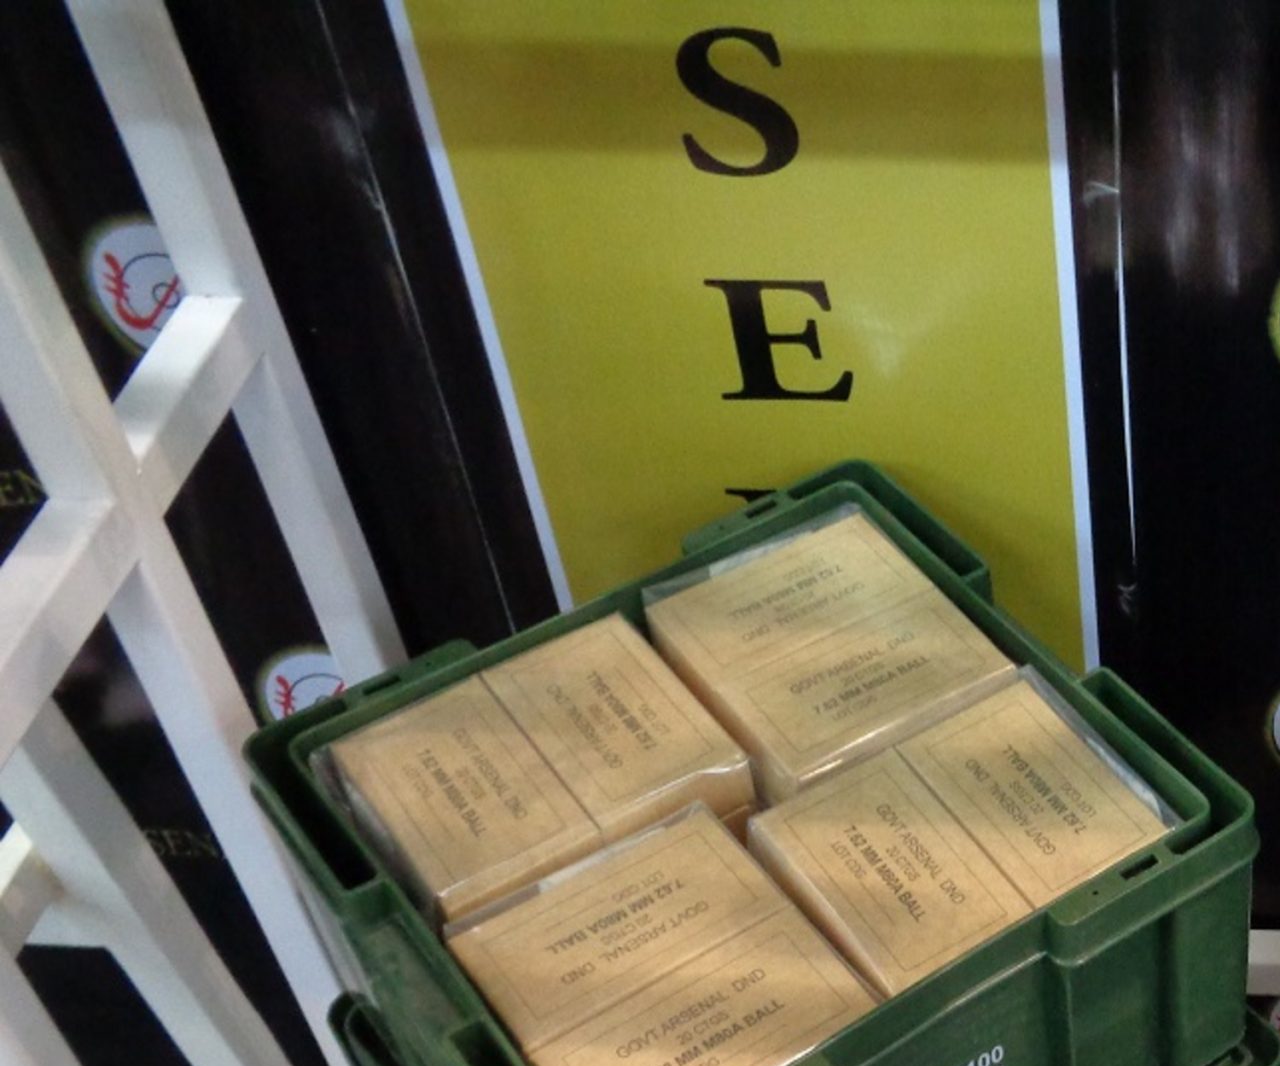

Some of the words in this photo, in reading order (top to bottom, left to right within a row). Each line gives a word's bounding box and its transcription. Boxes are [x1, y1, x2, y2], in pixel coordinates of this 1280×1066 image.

[1002, 744, 1030, 771] BALL
[1046, 795, 1069, 814] MM
[875, 803, 907, 830] GOVT
[900, 832, 943, 879] ARSENAL
[939, 878, 967, 904] DND
[844, 825, 866, 847] 7.62
[860, 845, 883, 866] MM
[897, 891, 926, 923] BALL
[654, 878, 685, 899] 7.62
[628, 894, 656, 913] MM
[668, 900, 710, 928] GOVT
[544, 930, 588, 955] BALL
[598, 922, 668, 963] ARSENAL
[560, 961, 596, 985] DND
[615, 1028, 660, 1059] GOVT
[660, 990, 730, 1036] ARSENAL
[730, 968, 767, 993] DND
[674, 1045, 702, 1066] MM
[742, 999, 785, 1027] BALL
